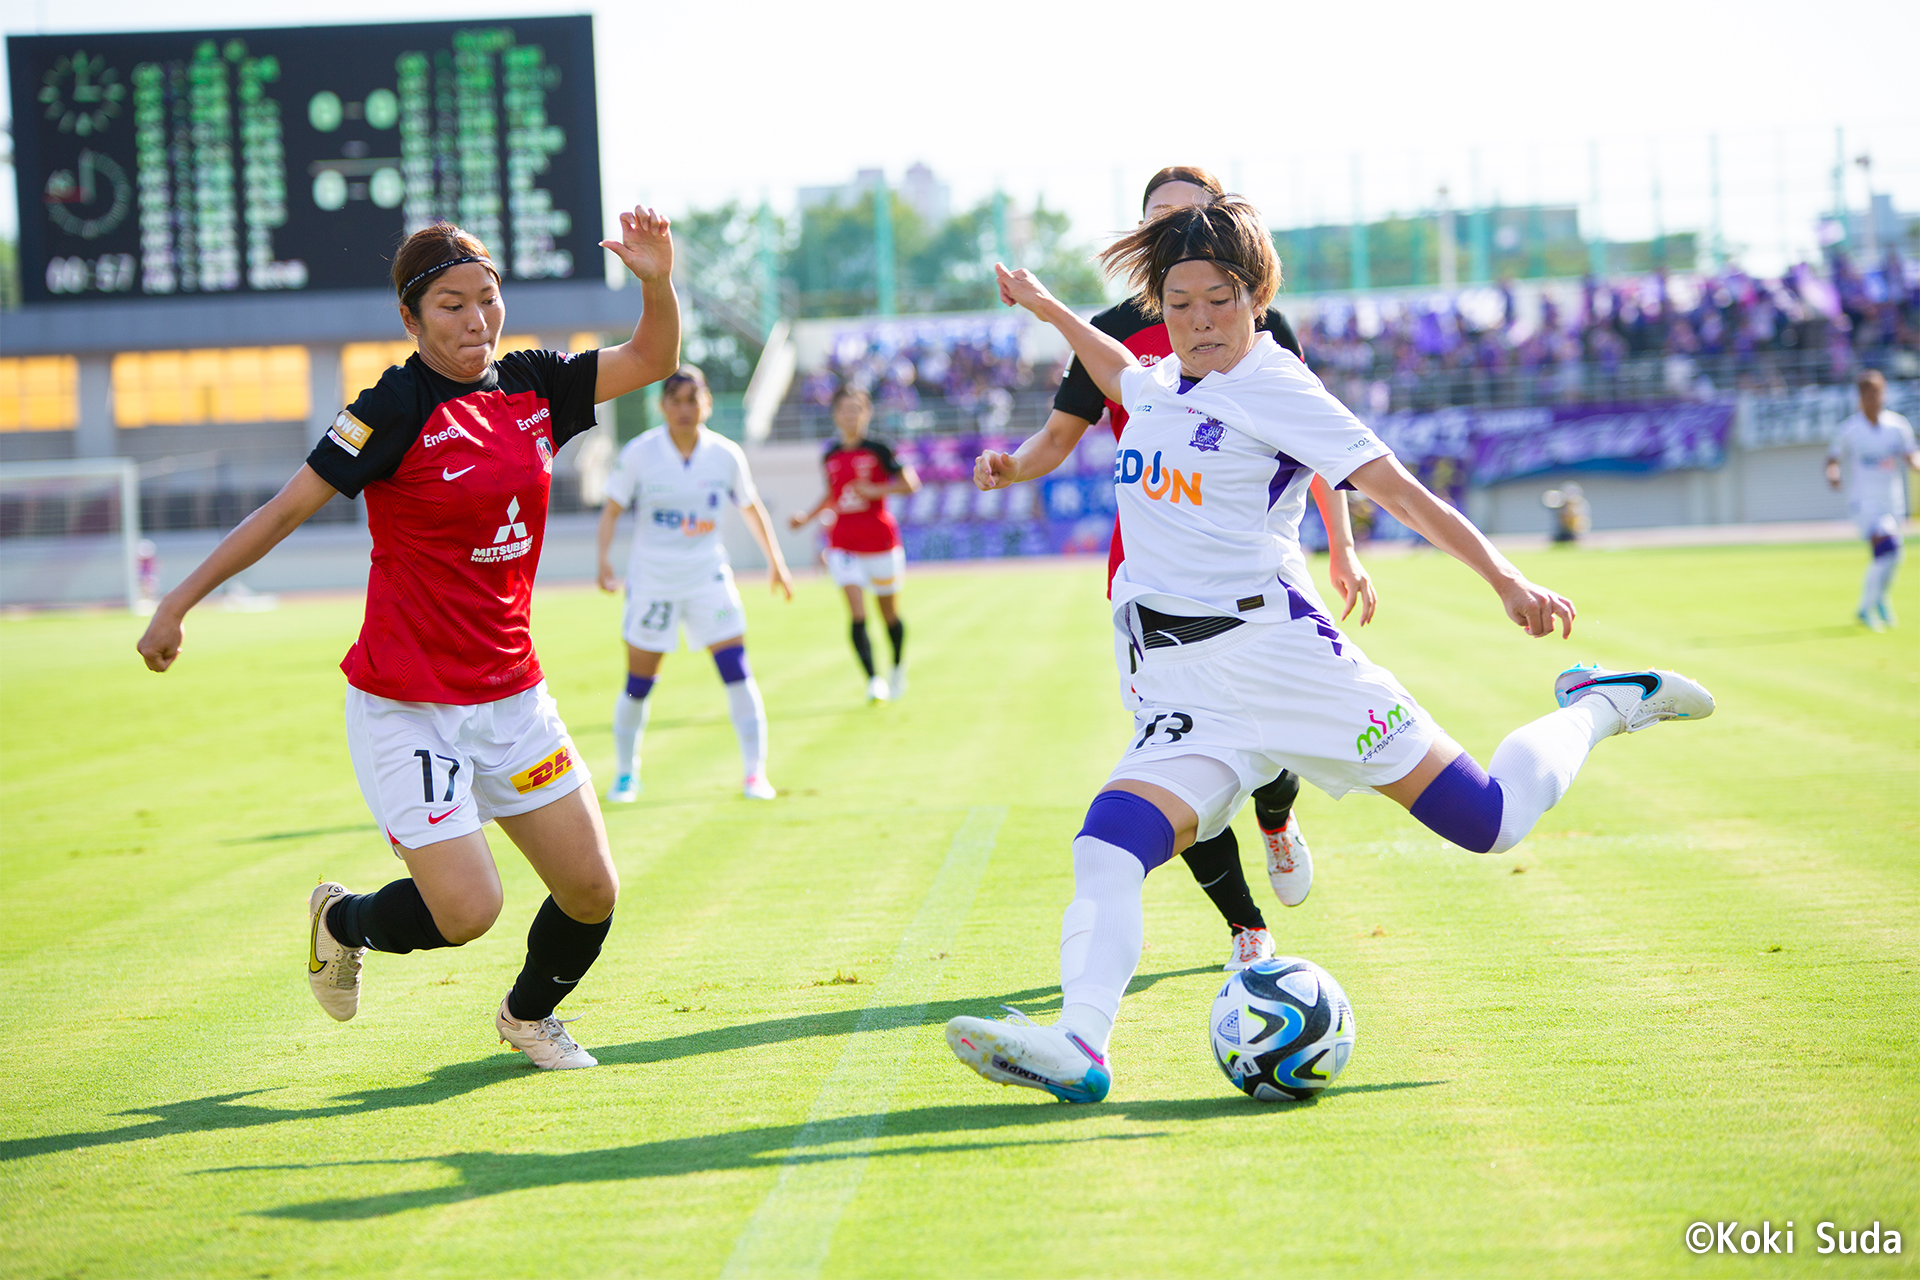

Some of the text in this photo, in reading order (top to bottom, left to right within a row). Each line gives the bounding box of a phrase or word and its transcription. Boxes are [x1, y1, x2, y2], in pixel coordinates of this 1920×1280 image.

[470, 555, 502, 563] HEAVY
[641, 601, 673, 631] 23
[1135, 712, 1193, 749] 13
[413, 749, 460, 803] 17
[527, 748, 573, 788] DH
